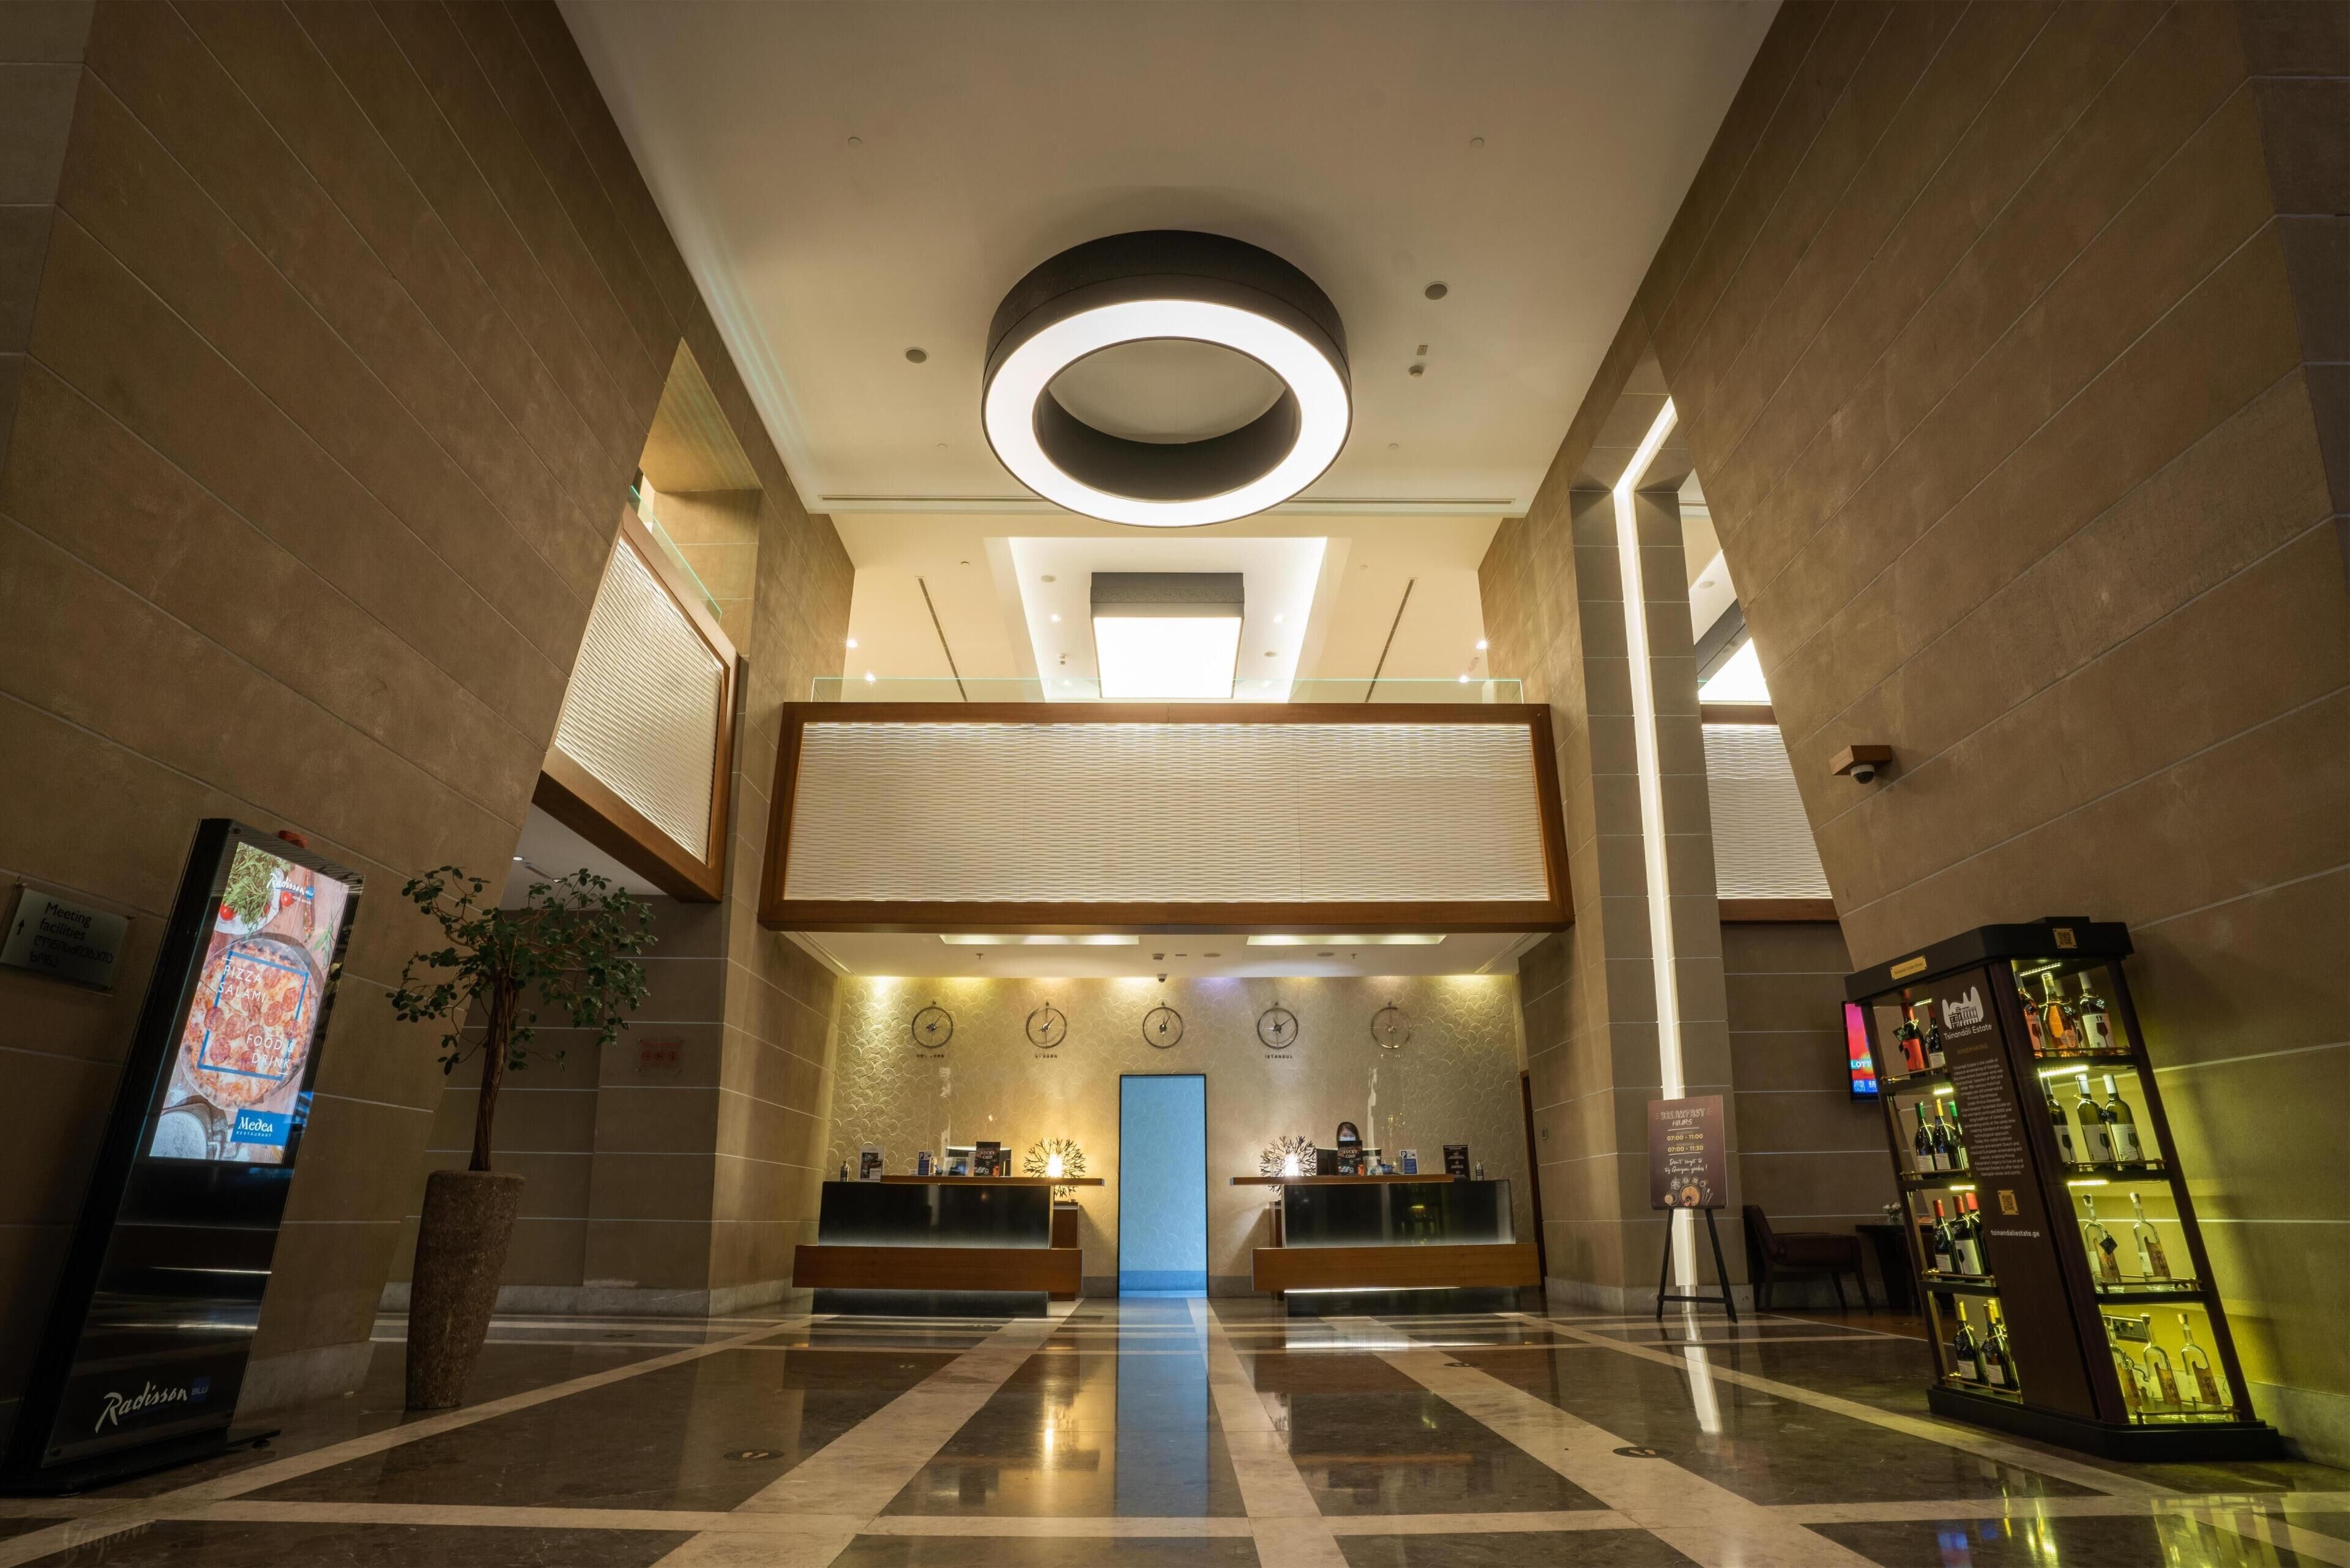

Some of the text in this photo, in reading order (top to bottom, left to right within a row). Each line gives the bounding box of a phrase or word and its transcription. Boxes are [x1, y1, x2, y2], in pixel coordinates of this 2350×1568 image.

[266, 873, 304, 895] Radisson
[45, 902, 92, 928] Meeting
[39, 918, 86, 941] facilities
[223, 965, 262, 984] PIZZA
[218, 982, 266, 1002] SALAMI
[1972, 1024, 1992, 1034] Estate
[246, 1034, 295, 1053] FOOD &
[251, 1050, 291, 1069] DRINK
[1660, 1108, 1705, 1120] BREAKFAST
[237, 1115, 273, 1133] Medea
[236, 1130, 272, 1138] RESTAURANT
[1990, 1230, 2040, 1238] tsinandaliestate.ge
[95, 1381, 209, 1433] Radisson BLU
